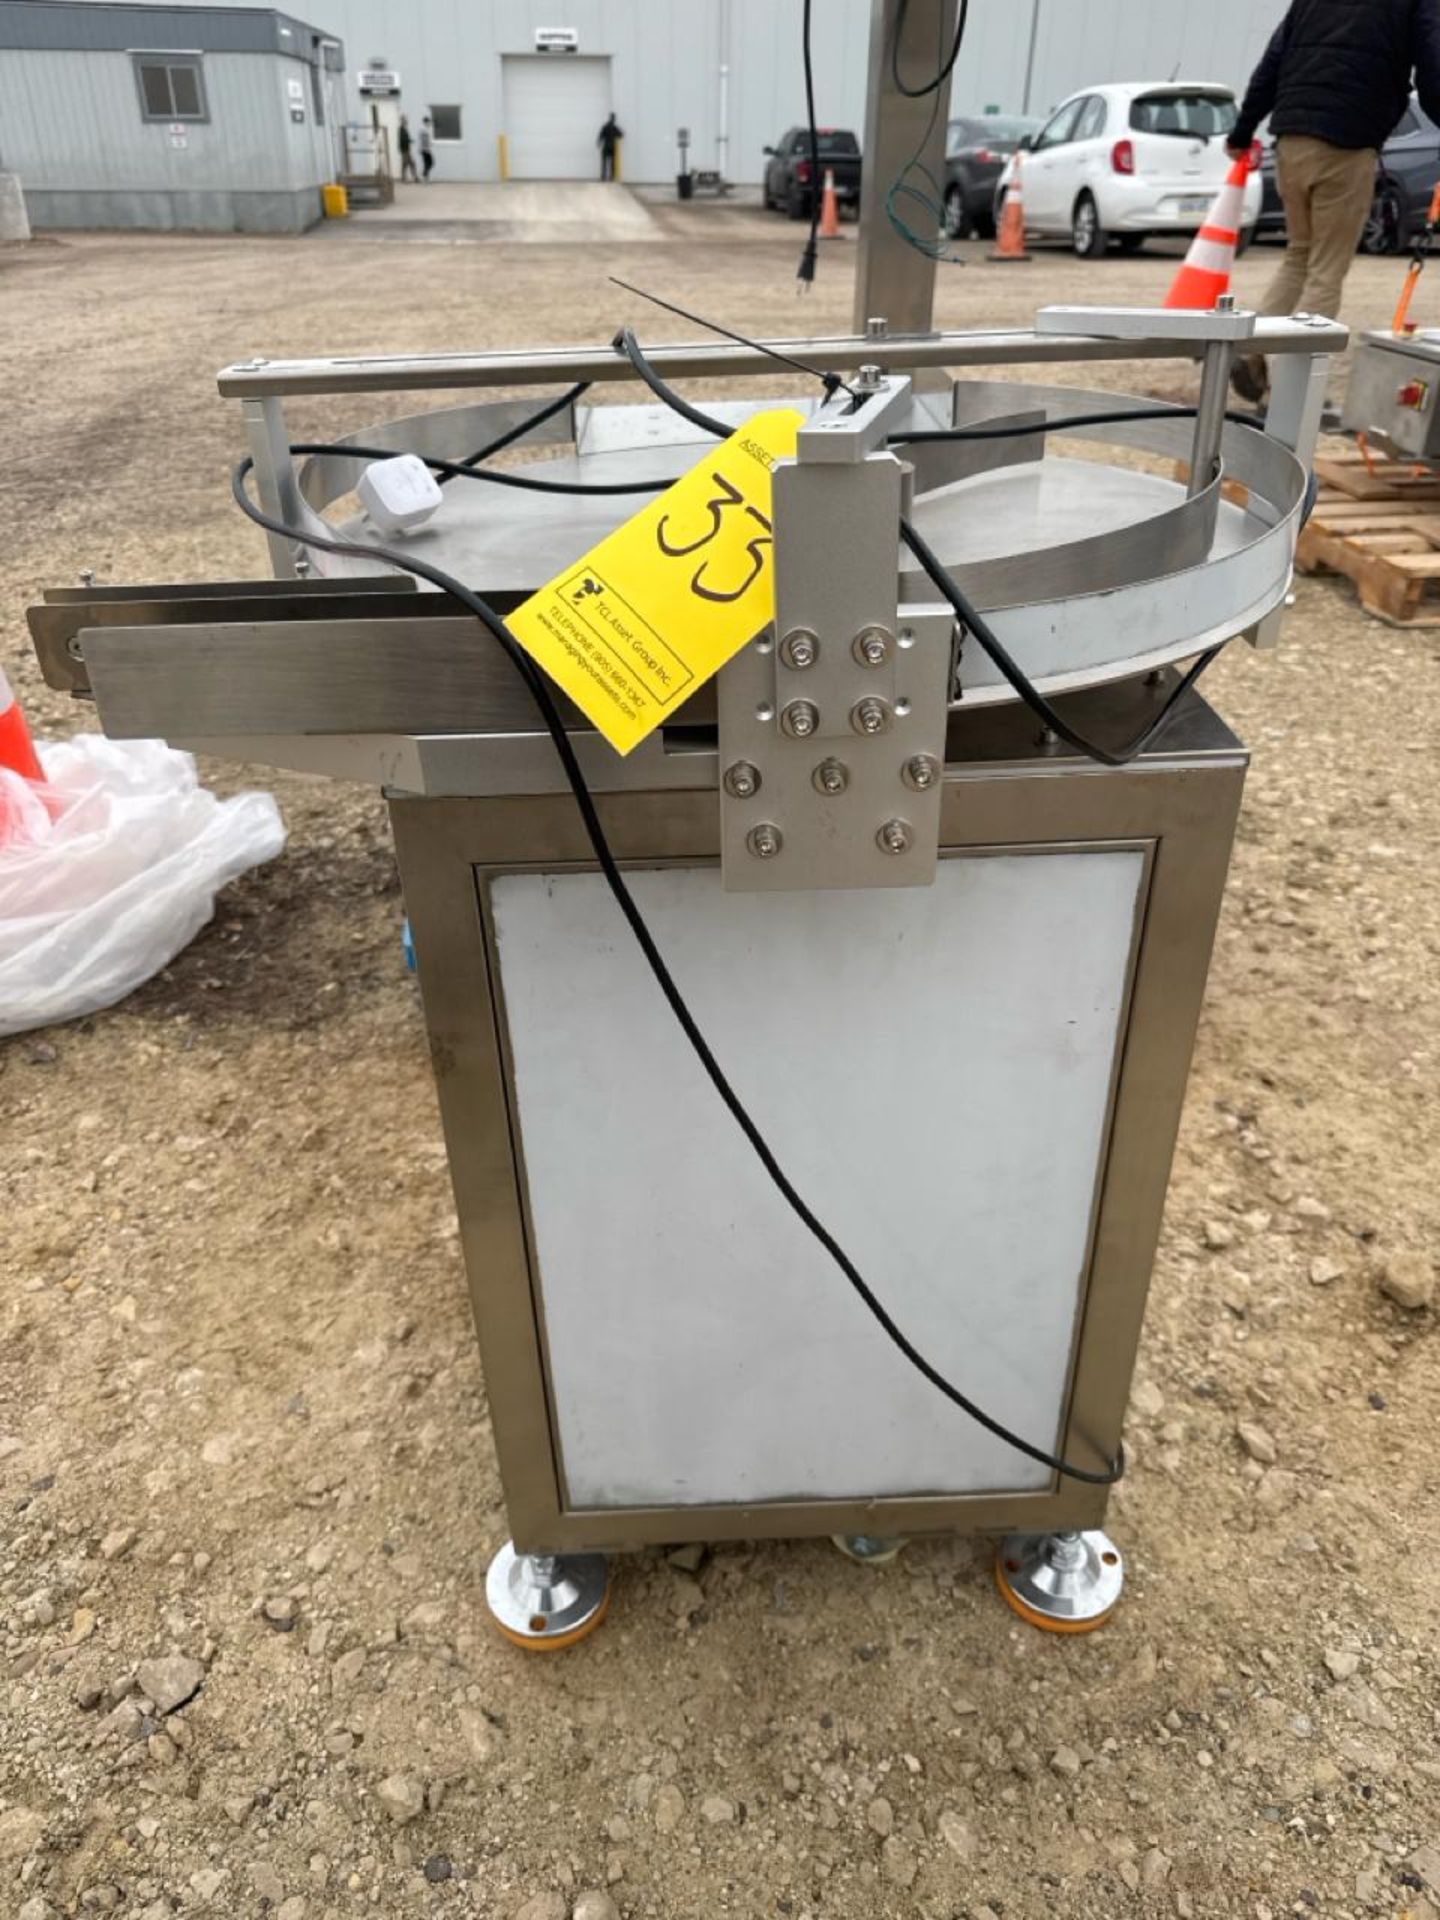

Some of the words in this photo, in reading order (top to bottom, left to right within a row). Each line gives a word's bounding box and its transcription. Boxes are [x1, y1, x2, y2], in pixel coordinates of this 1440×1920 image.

[657, 472, 773, 602] 33
[550, 606, 594, 653] TELEPHONE
[595, 601, 611, 620] TCL
[609, 618, 633, 643] Asset
[632, 641, 657, 669] Group
[655, 666, 671, 687] Inc.
